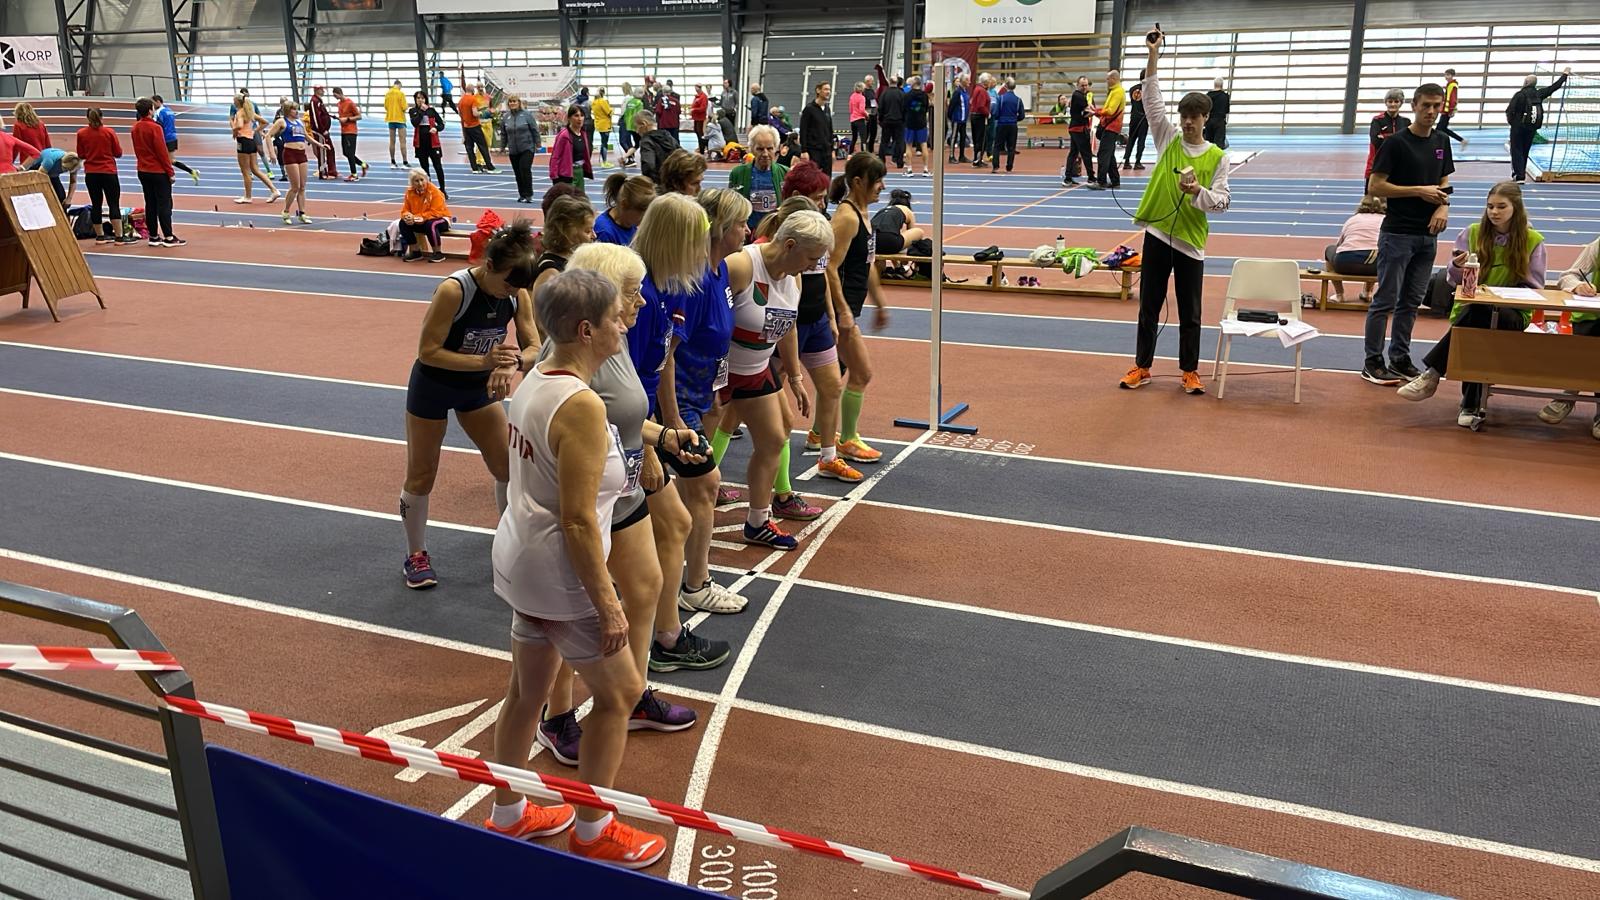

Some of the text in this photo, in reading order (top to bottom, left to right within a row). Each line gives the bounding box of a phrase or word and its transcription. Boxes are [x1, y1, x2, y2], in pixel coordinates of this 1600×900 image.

[1009, 16, 1033, 24] 2024
[18, 50, 52, 61] KORP
[763, 196, 769, 208] 8
[697, 844, 736, 896] 300
